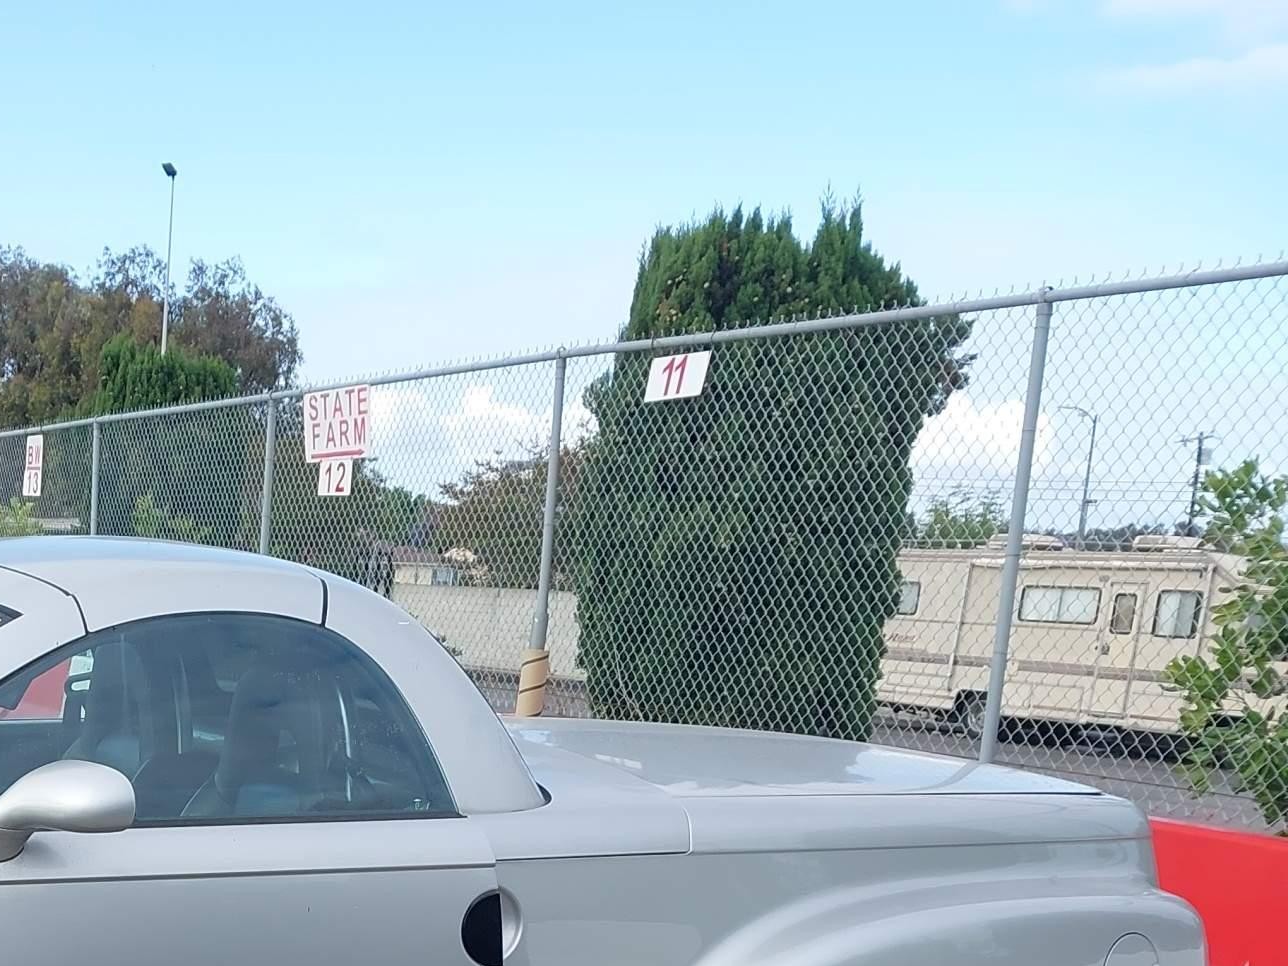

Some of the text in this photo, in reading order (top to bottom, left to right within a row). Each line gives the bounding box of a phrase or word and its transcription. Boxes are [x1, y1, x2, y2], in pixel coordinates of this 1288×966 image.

[662, 354, 688, 396] 11
[308, 387, 369, 421] STATE
[312, 417, 367, 450] FARM
[27, 471, 39, 494] 13
[324, 462, 347, 493] 12
